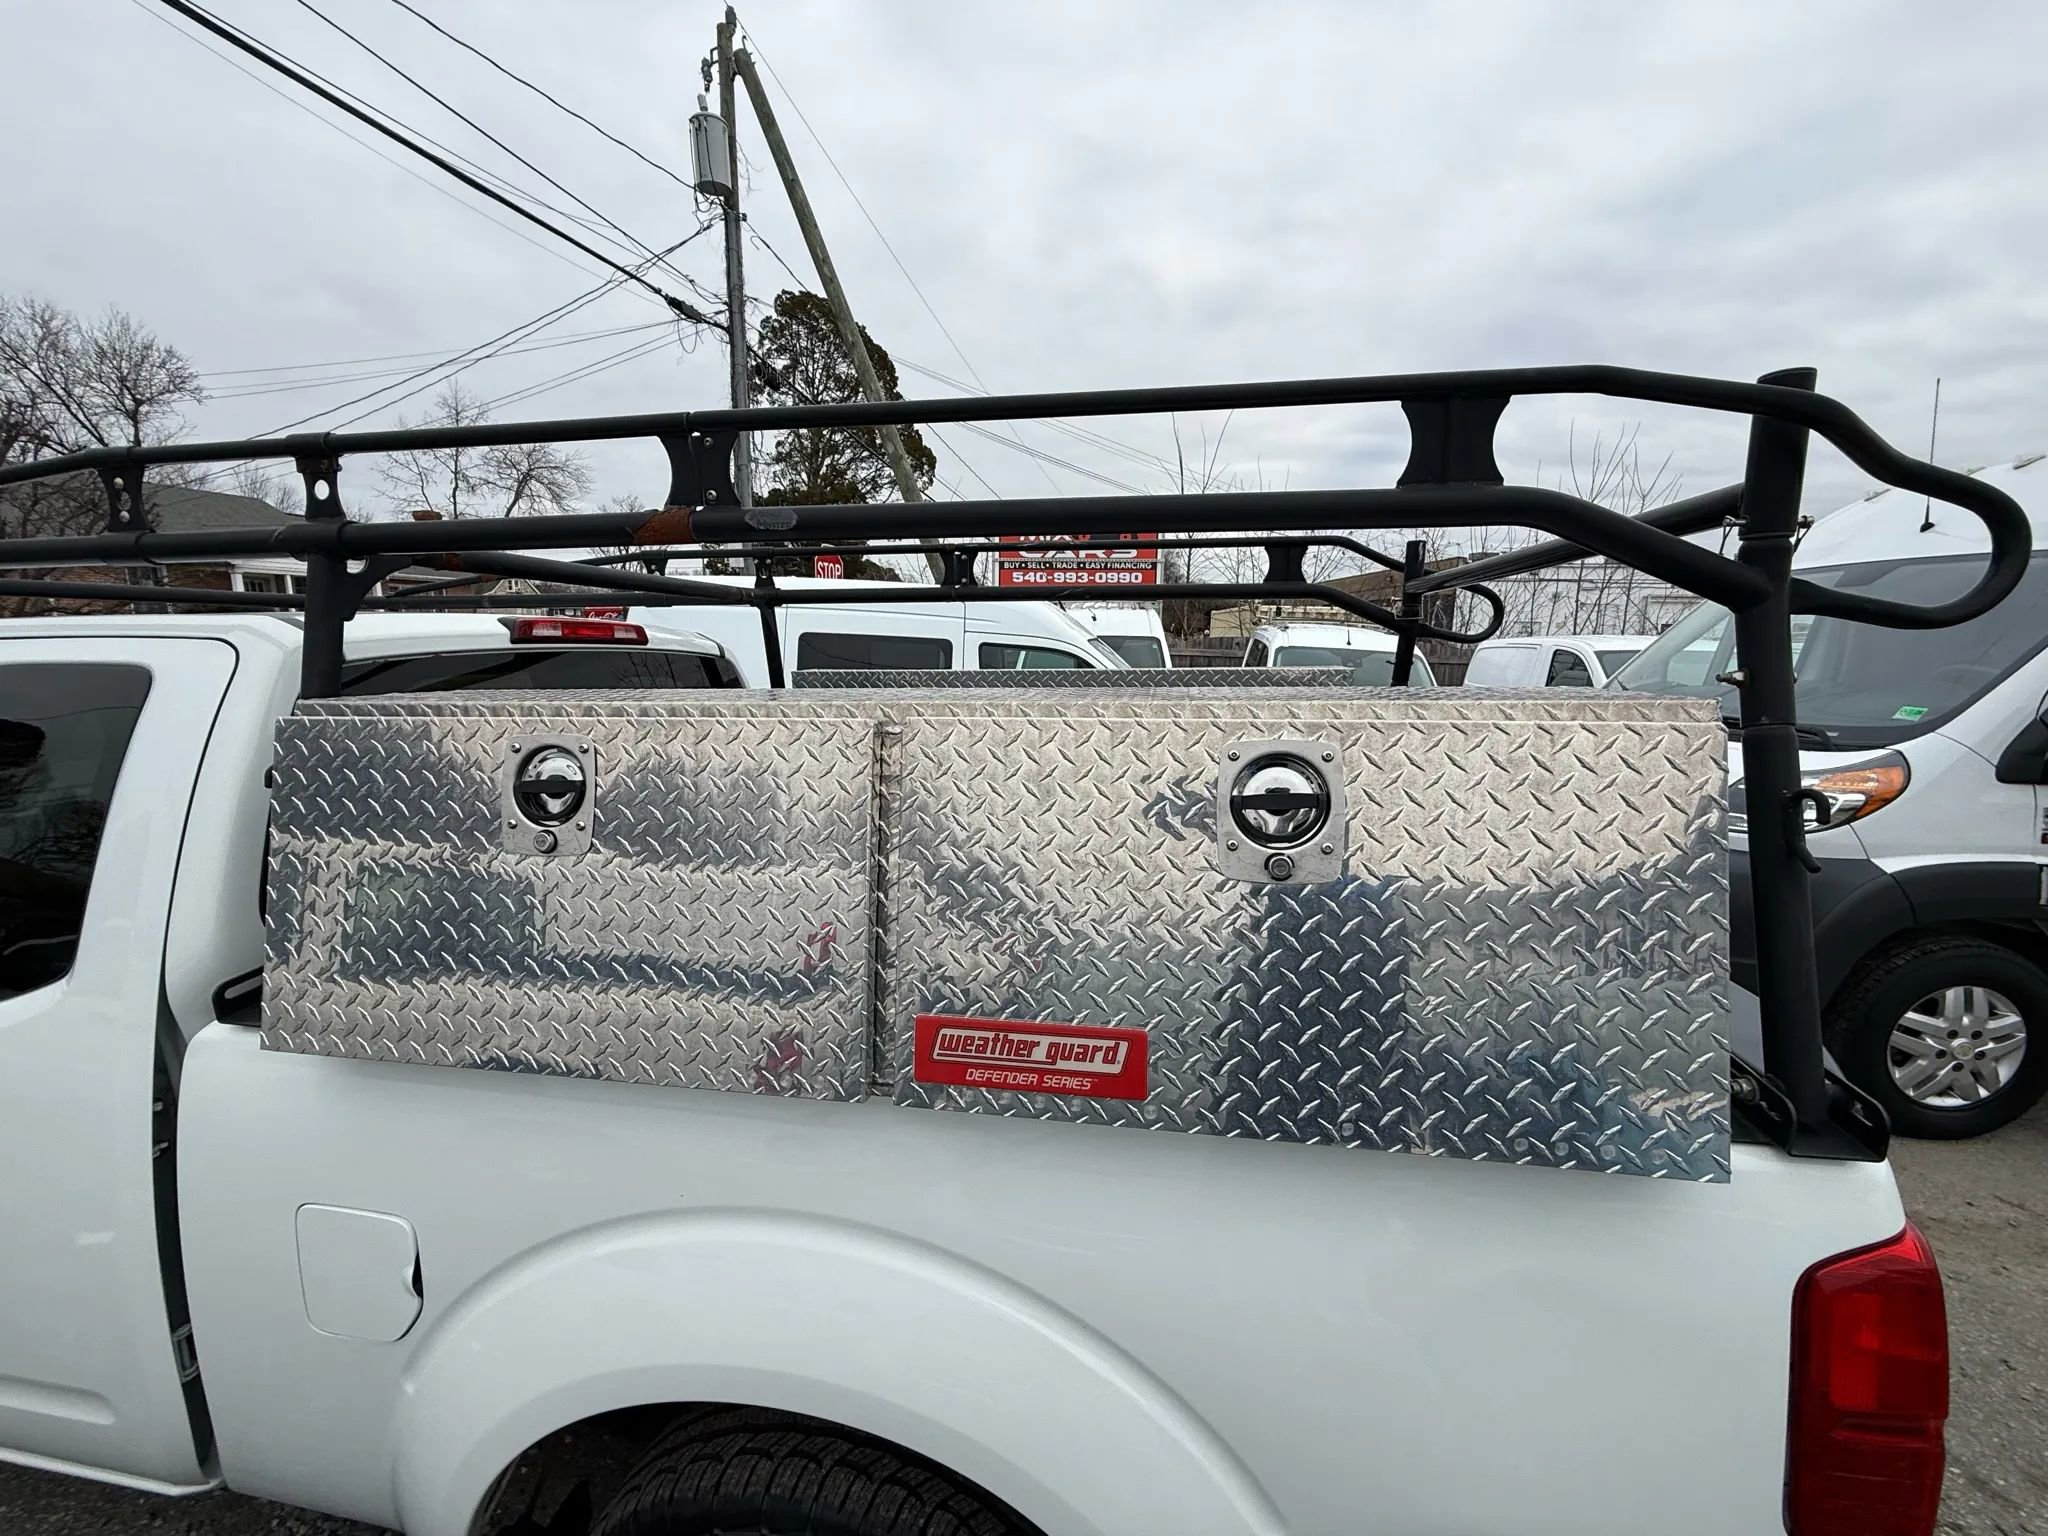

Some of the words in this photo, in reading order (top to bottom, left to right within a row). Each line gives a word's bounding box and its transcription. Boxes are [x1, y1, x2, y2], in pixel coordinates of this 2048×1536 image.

[817, 561, 842, 579] STOP
[1107, 562, 1152, 570] FINANCING
[1012, 571, 1143, 584] 540-993-0990
[938, 1032, 1041, 1059] weather
[1046, 1041, 1121, 1066] guard
[965, 1068, 1039, 1086] DEFENDER
[1041, 1074, 1093, 1091] SERIES
